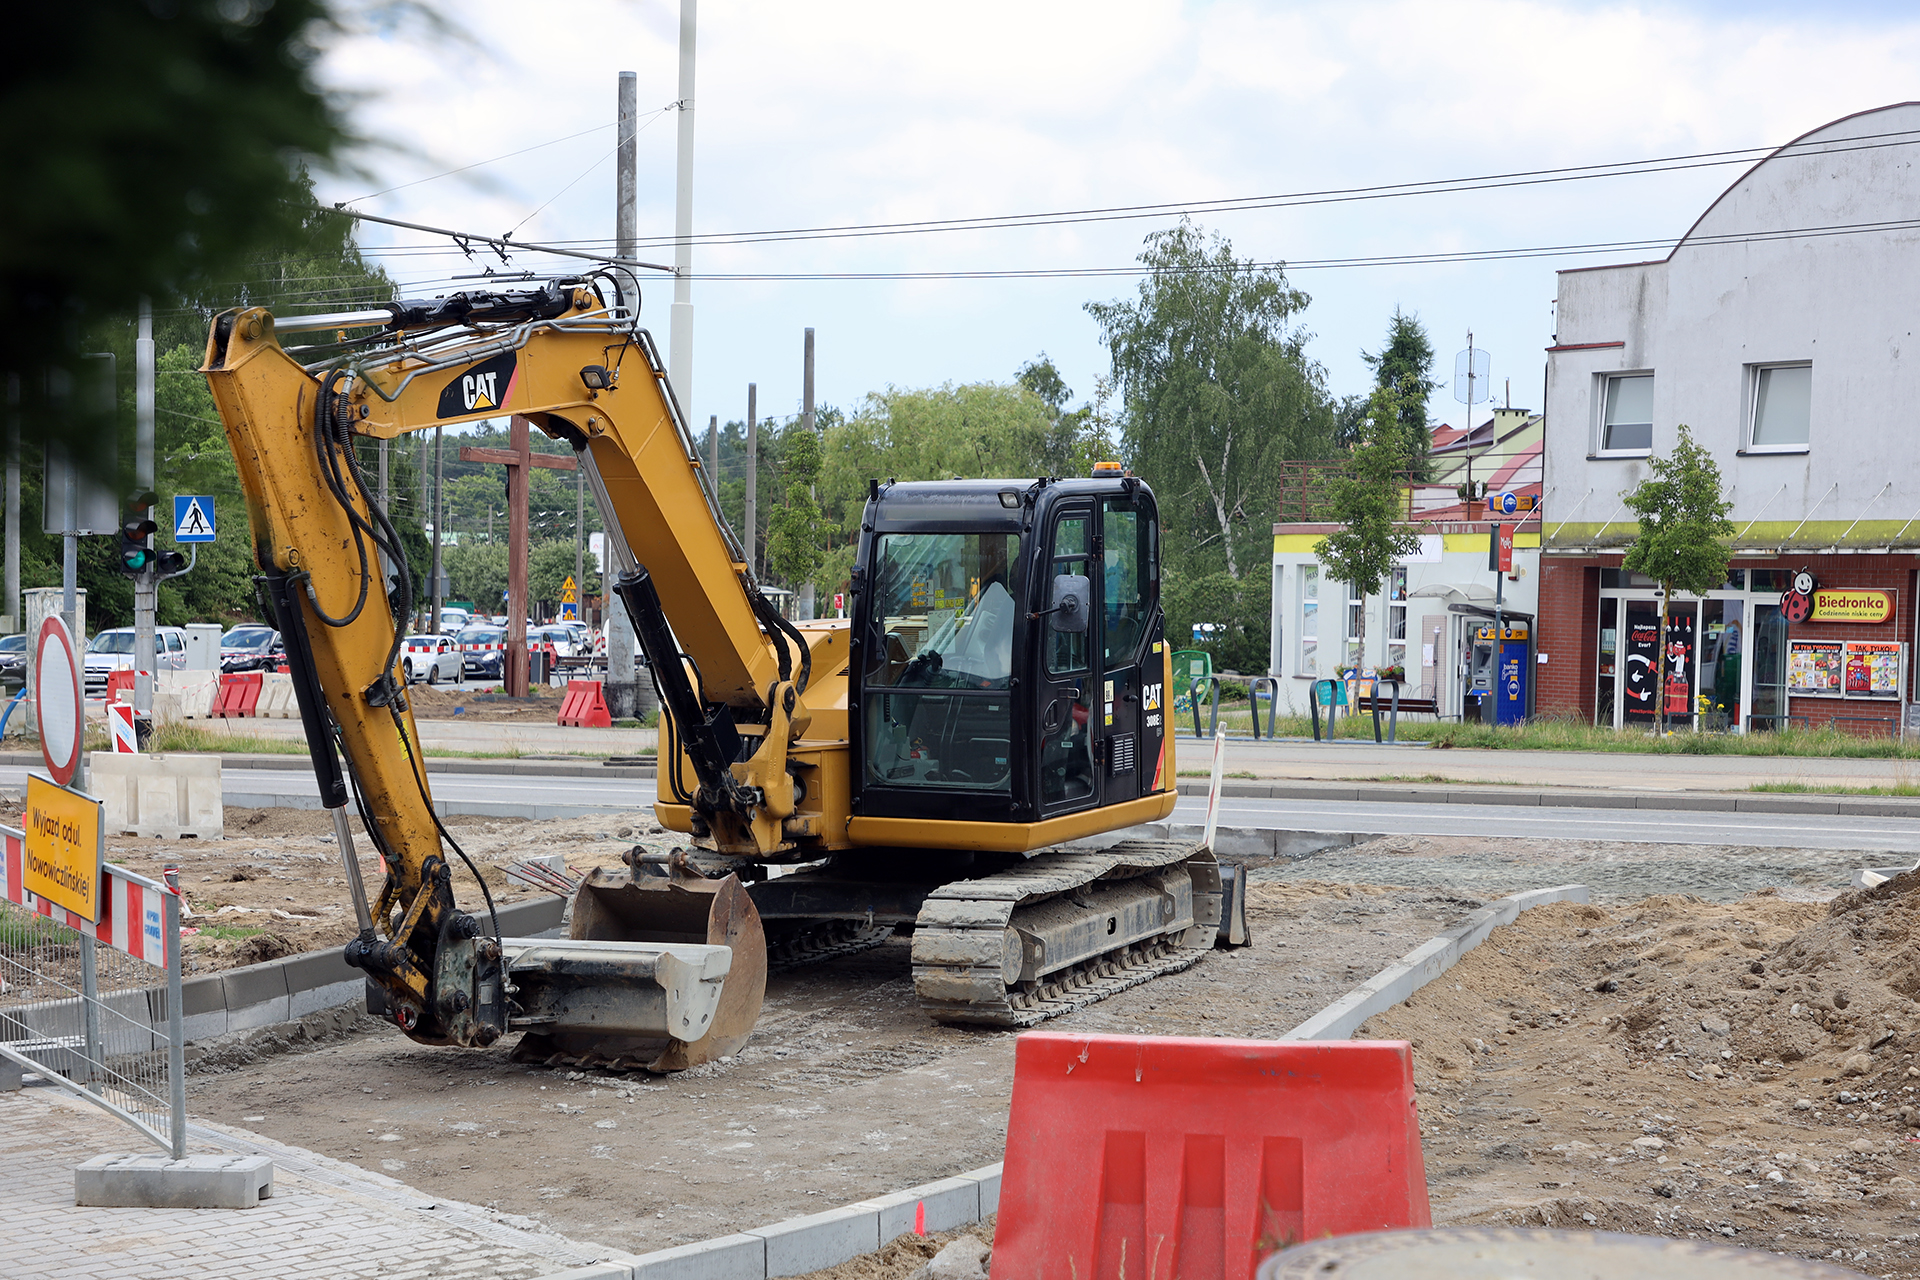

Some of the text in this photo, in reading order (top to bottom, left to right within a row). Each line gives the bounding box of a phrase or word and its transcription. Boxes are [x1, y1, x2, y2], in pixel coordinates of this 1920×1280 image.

[462, 371, 498, 411] CAT
[1818, 595, 1884, 609] Biedronka
[1143, 683, 1162, 710] CAT
[32, 806, 82, 848] Wyjazd od ul.
[26, 847, 90, 904] Nowowiczlińskiej
